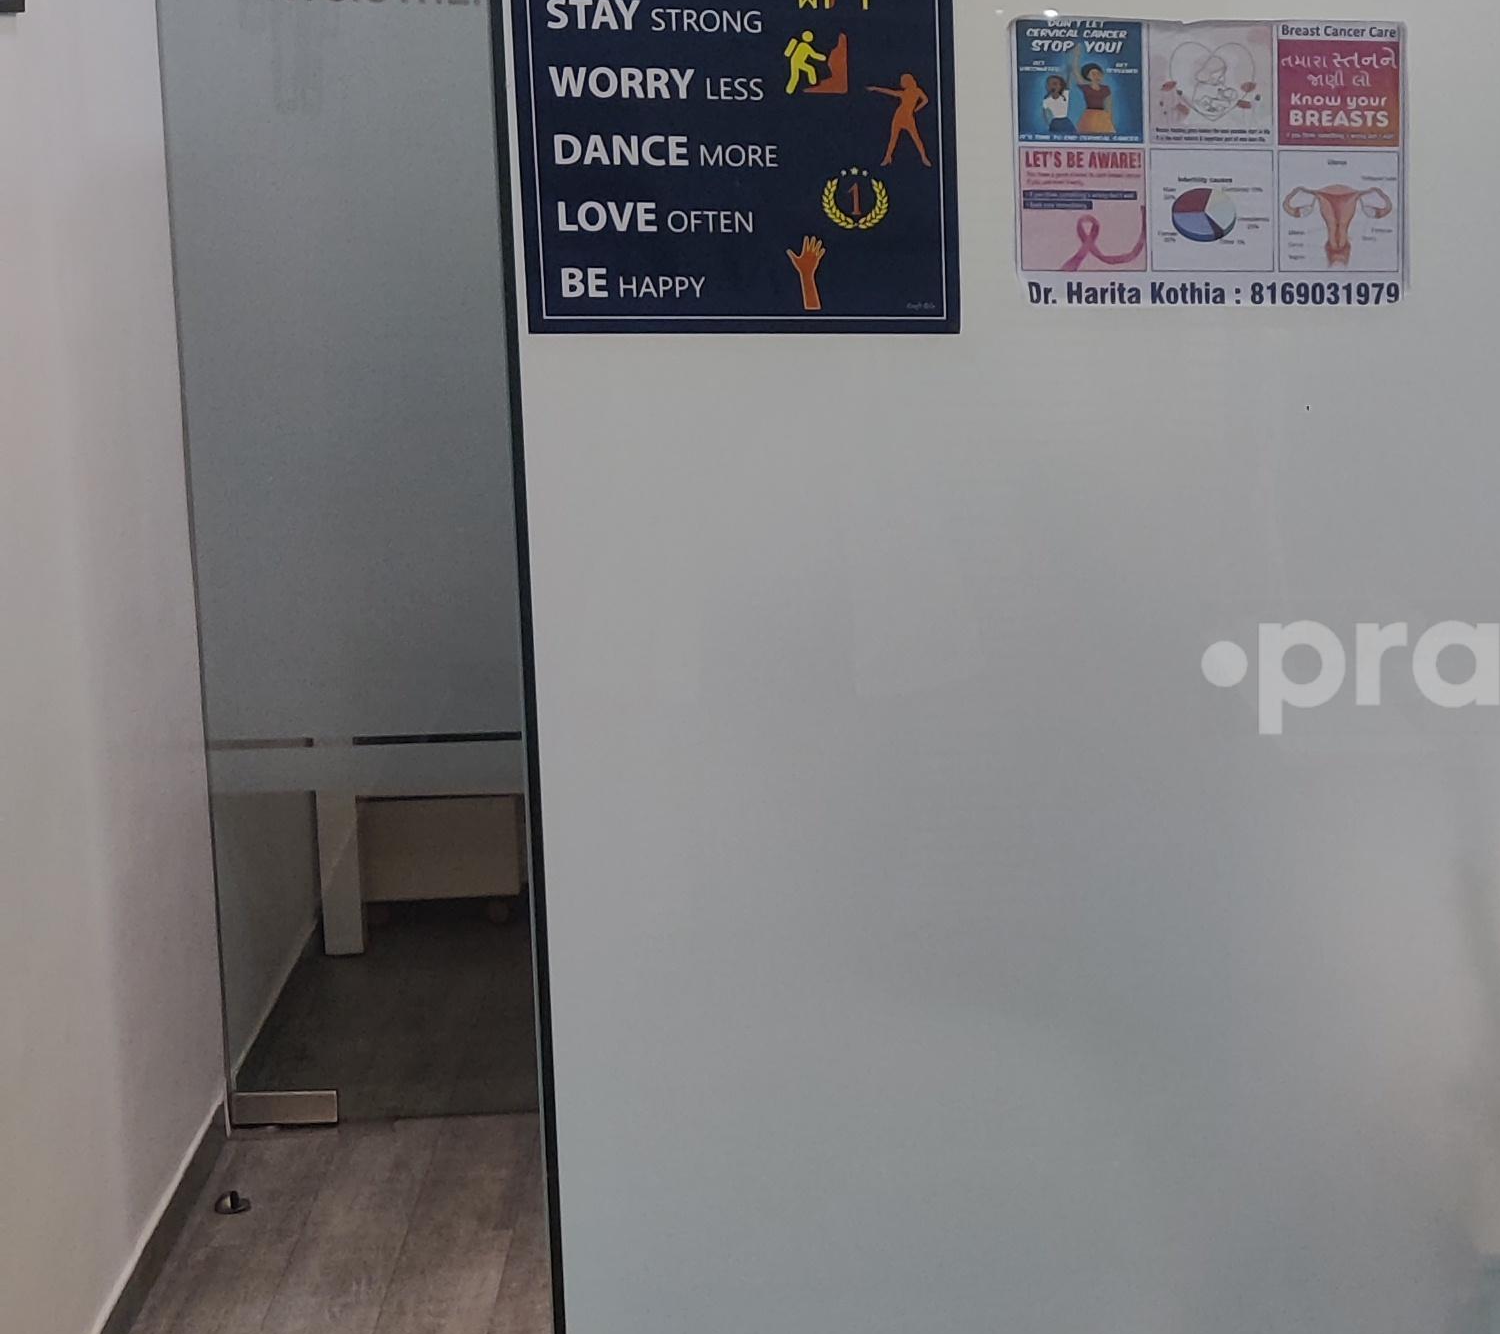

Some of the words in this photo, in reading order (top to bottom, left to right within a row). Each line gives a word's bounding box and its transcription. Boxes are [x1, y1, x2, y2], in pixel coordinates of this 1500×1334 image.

[650, 7, 763, 34] STRONG
[1281, 24, 1321, 37] Breast
[1324, 26, 1366, 37] Cancer
[1369, 26, 1397, 38] Care
[1026, 28, 1078, 38] CERVICAL
[1083, 29, 1128, 40] CANCER
[1031, 39, 1075, 53] STOP
[1084, 40, 1123, 54] YOU!
[549, 65, 695, 101] WORRY
[705, 75, 765, 102] LESS
[1290, 93, 1341, 106] Know
[1346, 94, 1388, 109] your
[1289, 110, 1390, 127] BREASTS
[553, 134, 689, 167] DANCE
[699, 143, 779, 168] MORE
[1025, 150, 1062, 168] LET'S
[1066, 151, 1085, 168] BE
[1088, 151, 1142, 169] AWARE!
[556, 200, 658, 234] LOVE
[667, 208, 754, 234] OFTEN
[560, 267, 609, 298] BE
[618, 275, 706, 300] HAPPY
[1028, 281, 1057, 306] Dr.
[1066, 281, 1142, 305] Harita
[1150, 281, 1226, 305] Kothia
[1250, 281, 1400, 305] 8169031979
